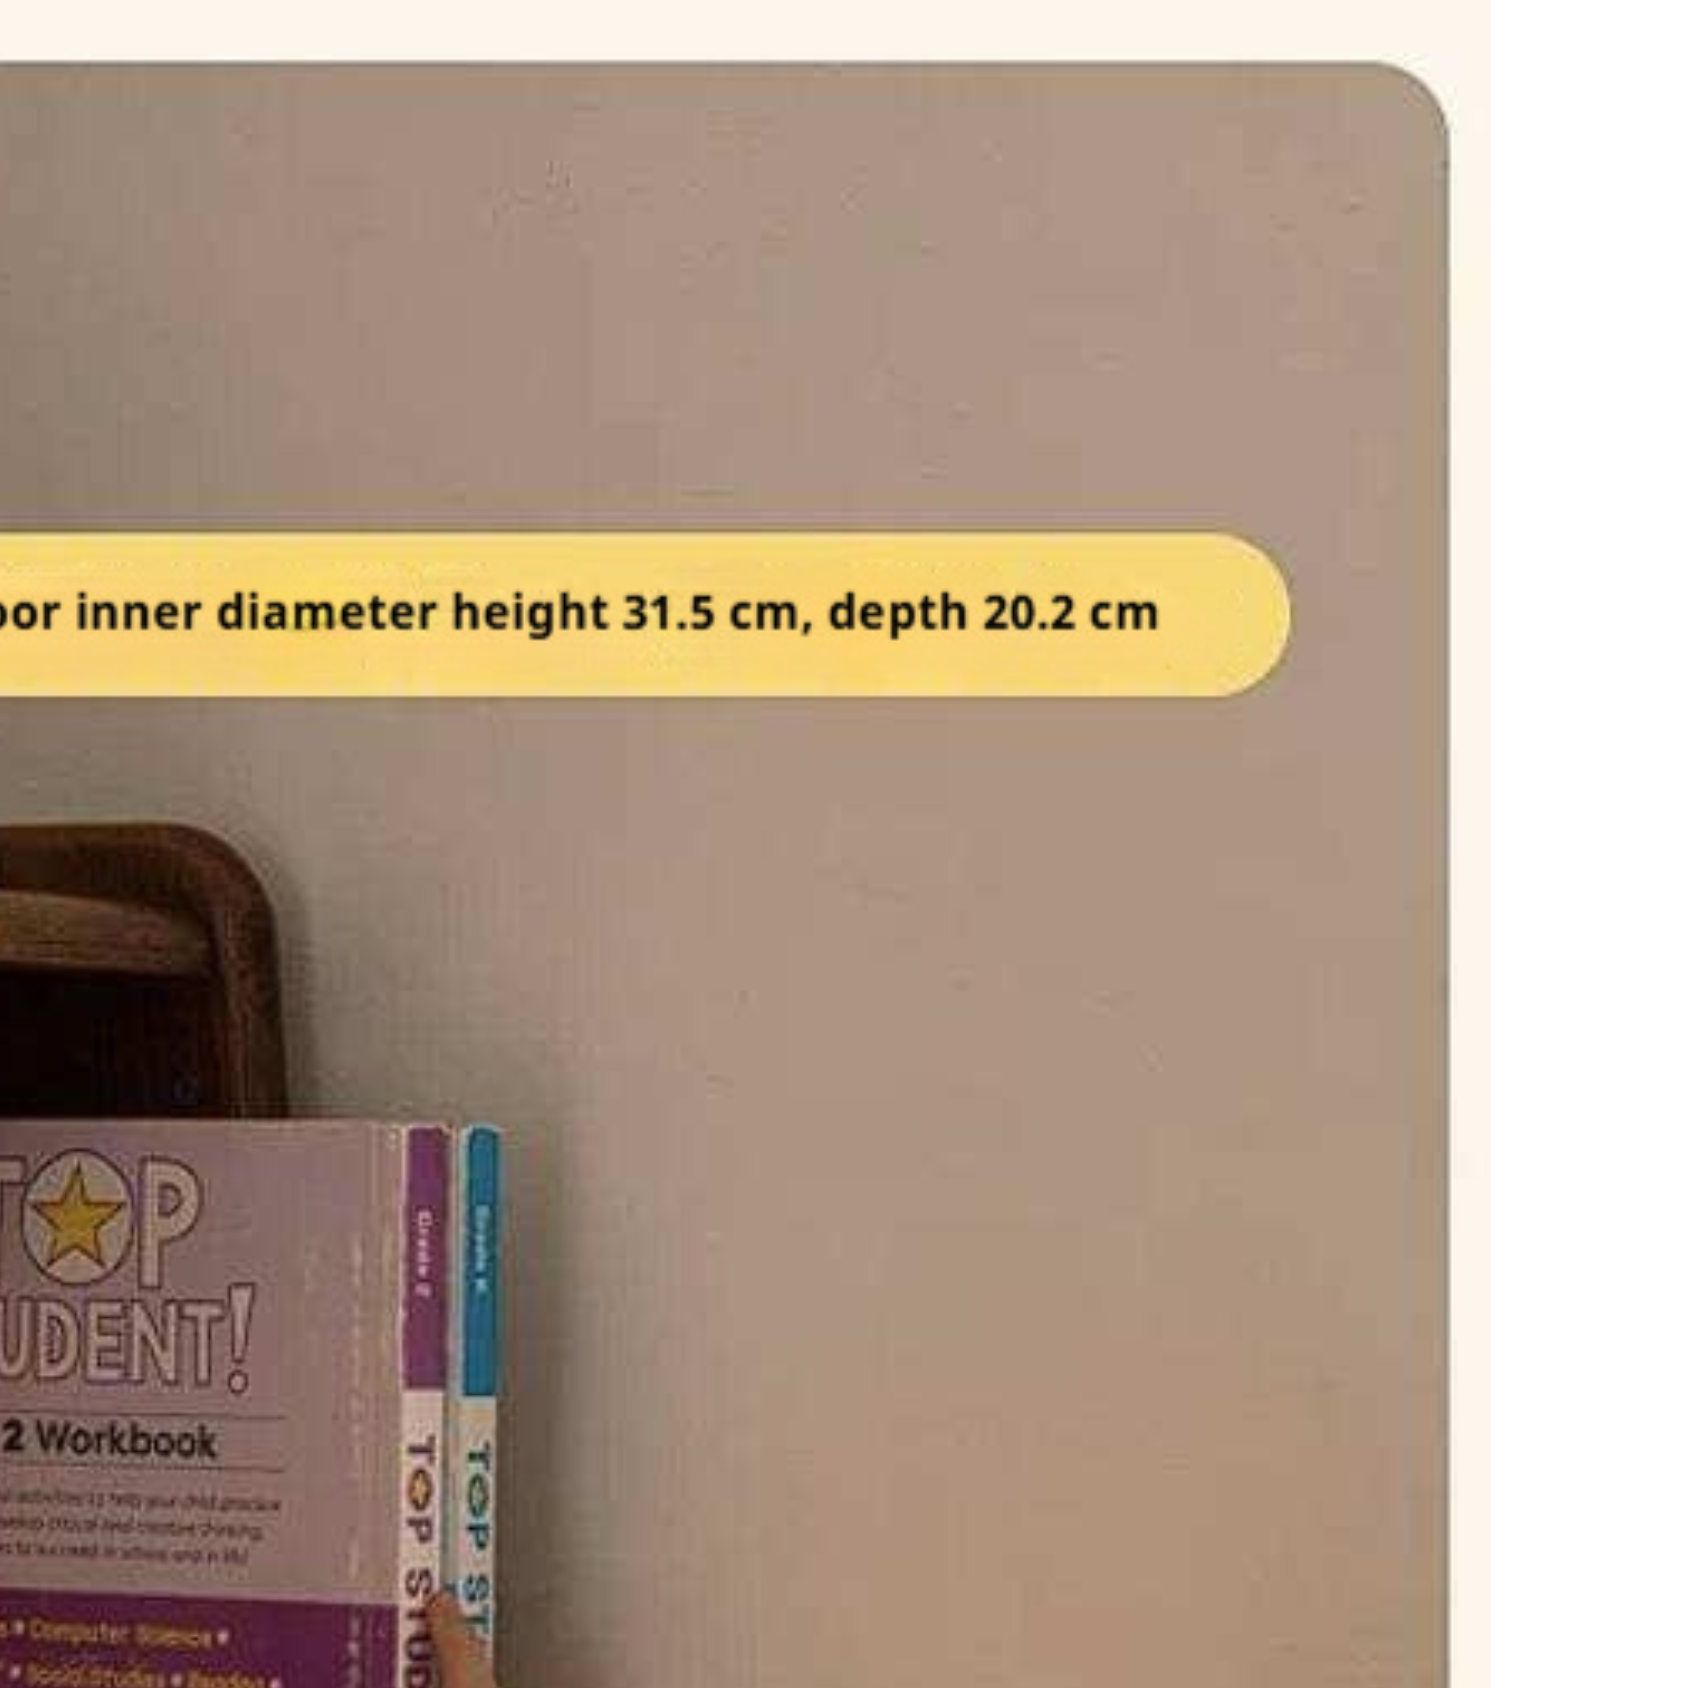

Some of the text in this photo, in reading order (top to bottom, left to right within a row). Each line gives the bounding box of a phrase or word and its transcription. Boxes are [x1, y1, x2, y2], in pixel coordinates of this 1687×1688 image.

[1, 1418, 25, 1452] 2
[34, 1419, 218, 1459] Workbook
[405, 1435, 437, 1546] TOP
[466, 1441, 491, 1550] TOP
[29, 1617, 213, 1648] Computer Science
